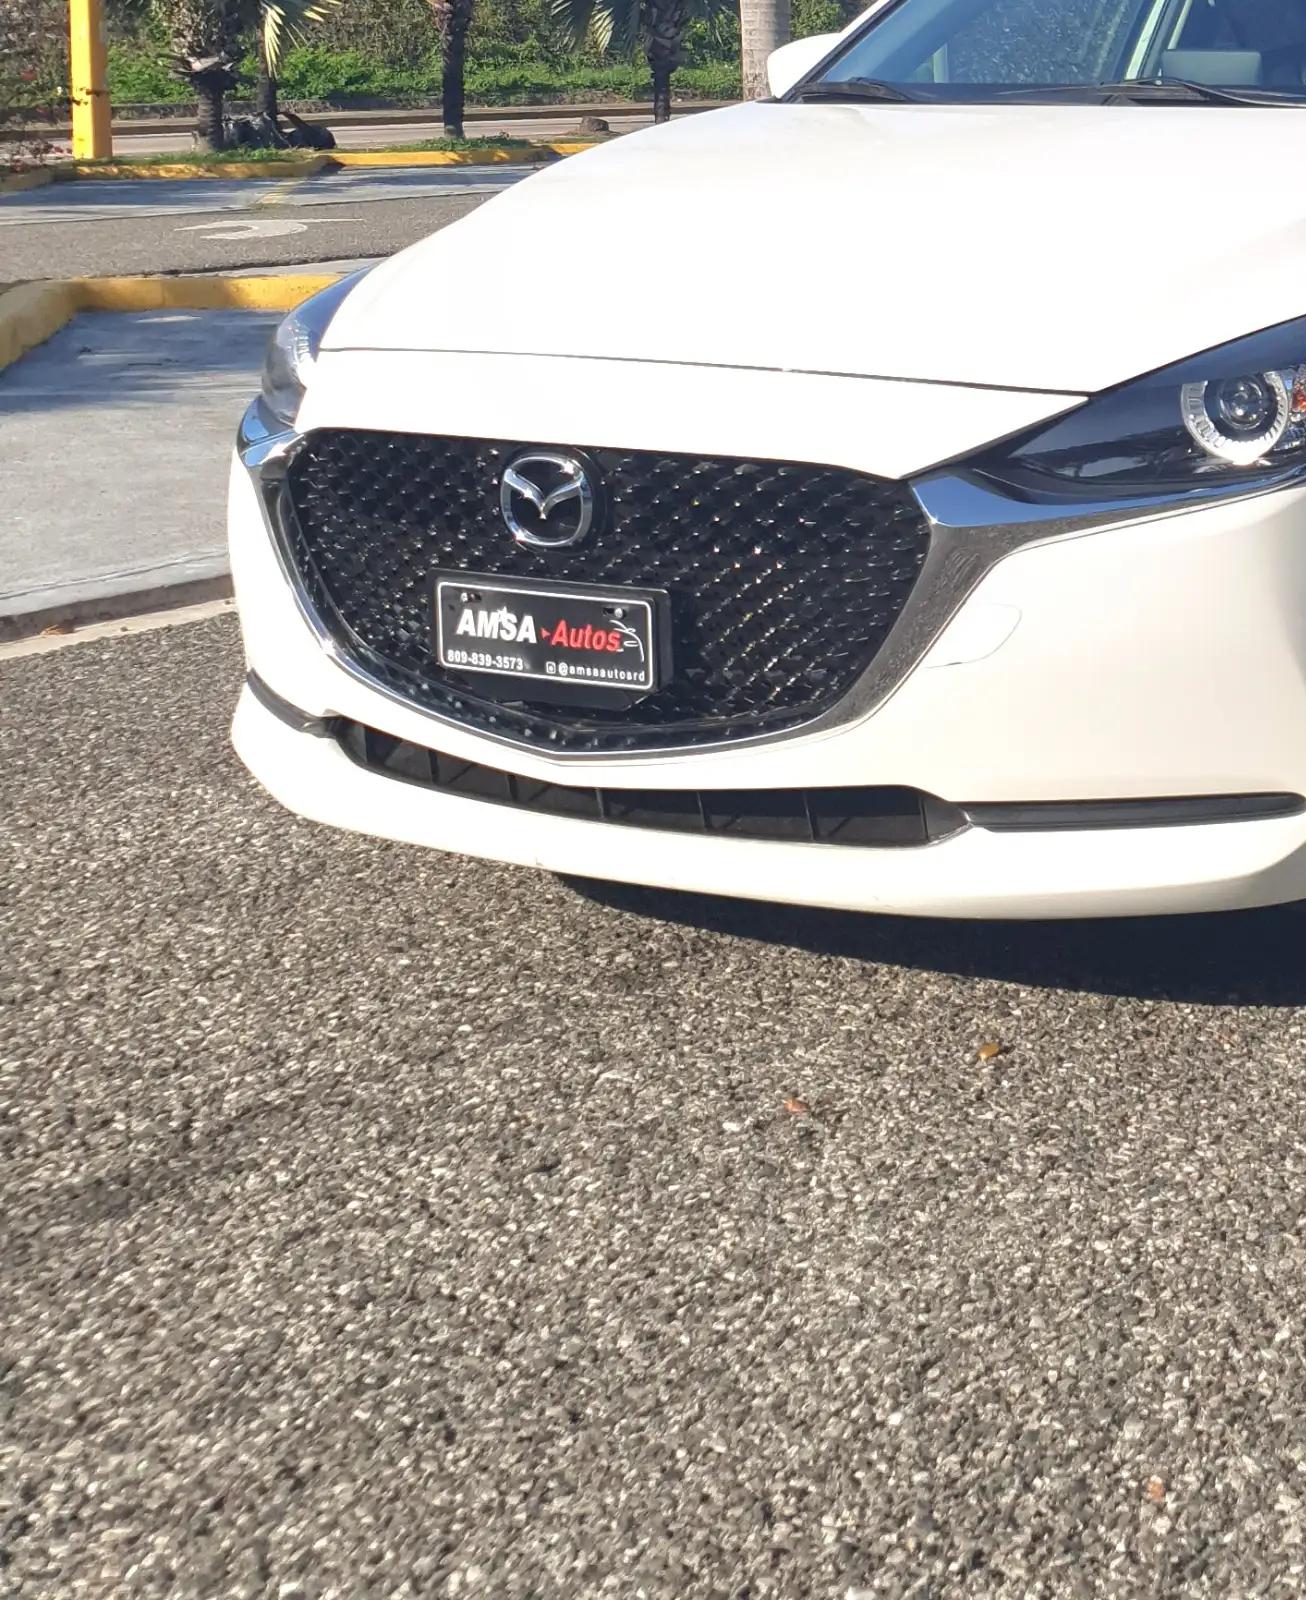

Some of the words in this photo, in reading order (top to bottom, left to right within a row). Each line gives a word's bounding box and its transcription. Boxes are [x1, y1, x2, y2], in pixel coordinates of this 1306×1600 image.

[456, 608, 537, 644] AMSA
[551, 619, 622, 651] Autos
[447, 649, 524, 671] 809-839-3573
